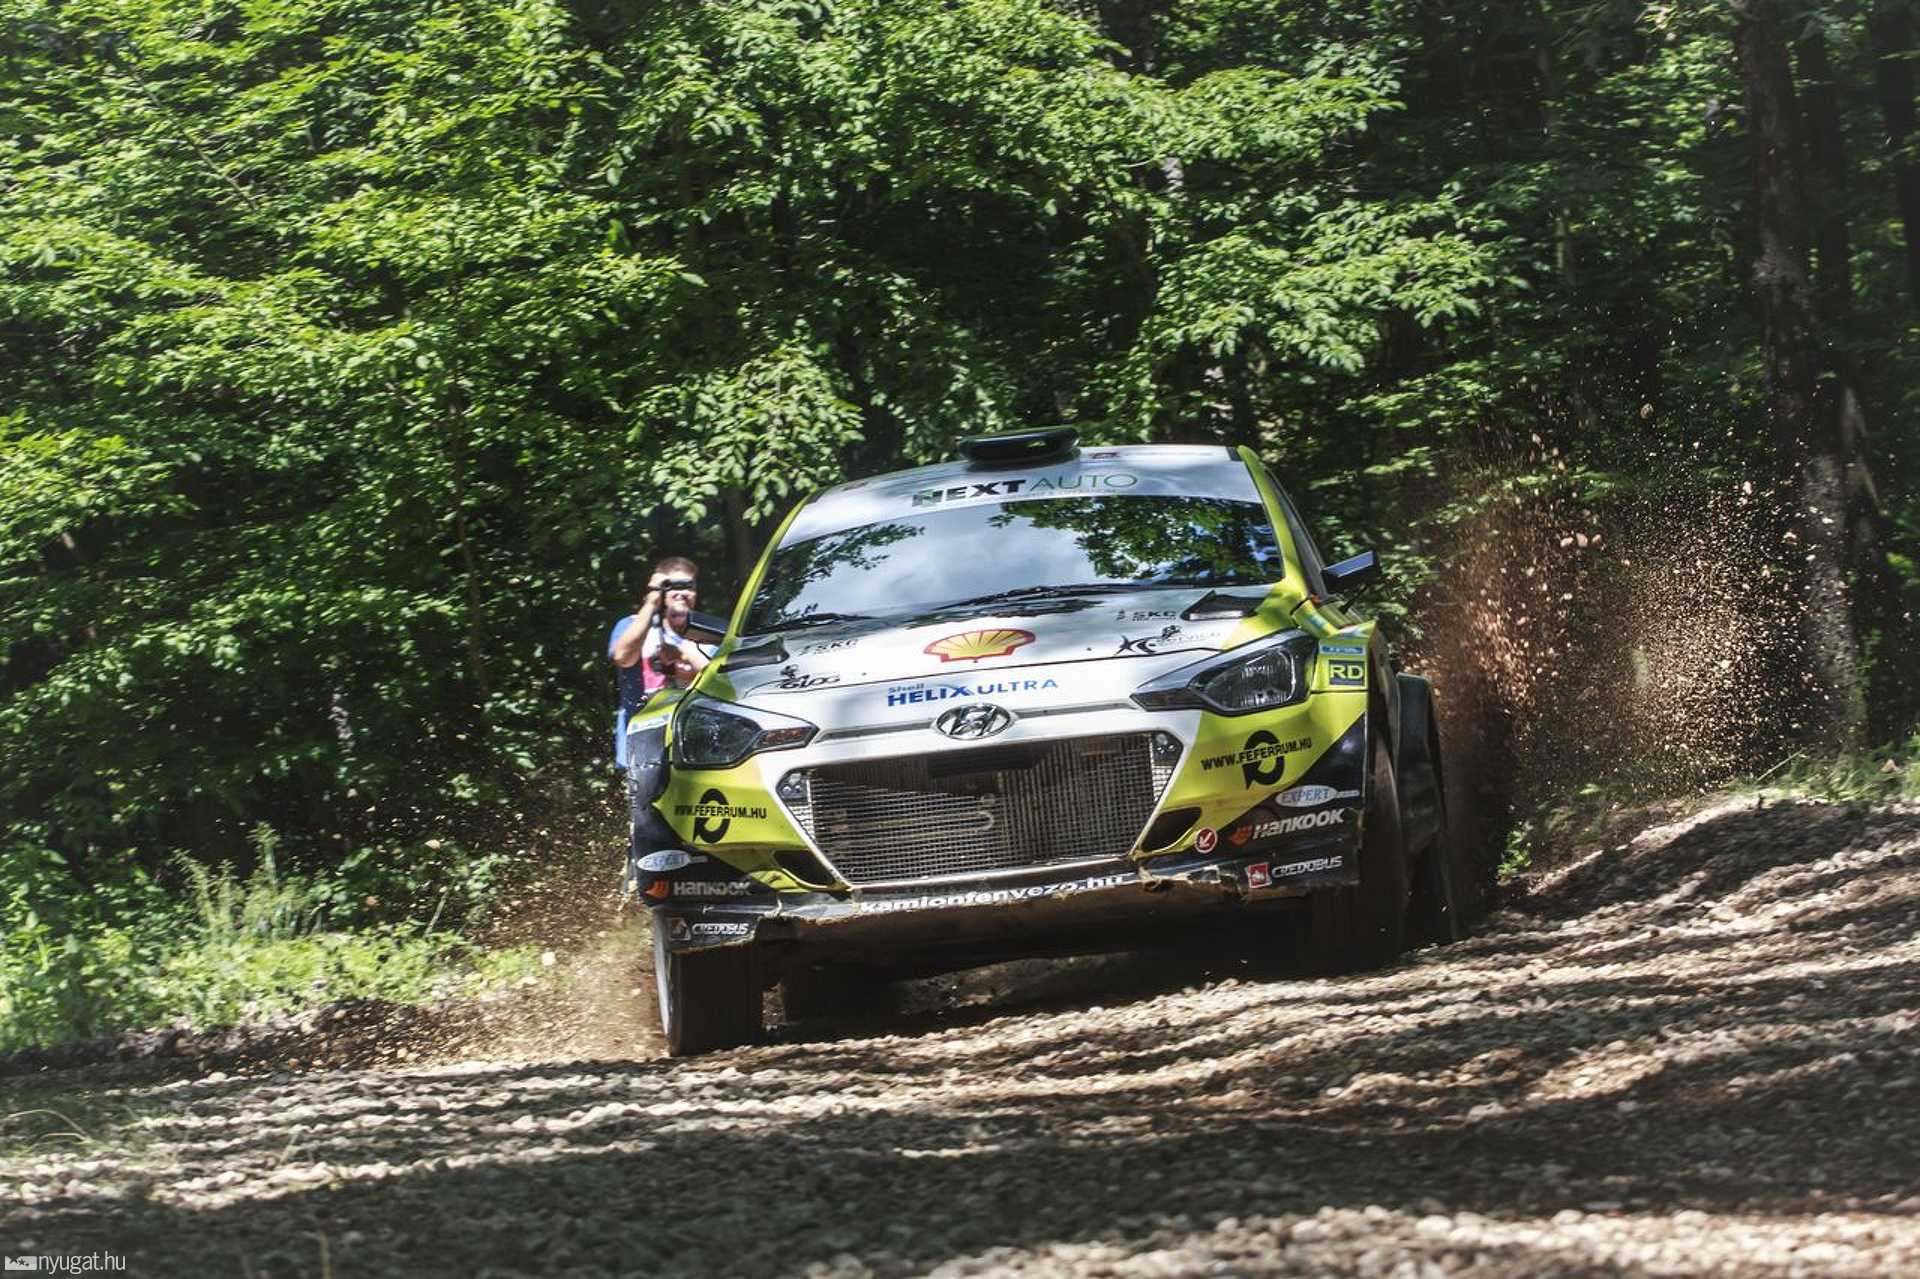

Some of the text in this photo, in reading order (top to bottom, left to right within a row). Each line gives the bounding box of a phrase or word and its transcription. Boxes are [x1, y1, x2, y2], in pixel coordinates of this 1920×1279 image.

[911, 473, 1138, 507] NEXT AUTO
[1330, 664, 1363, 679] RD
[887, 679, 1058, 706] HELIX ULTRA
[888, 683, 925, 693] Shell
